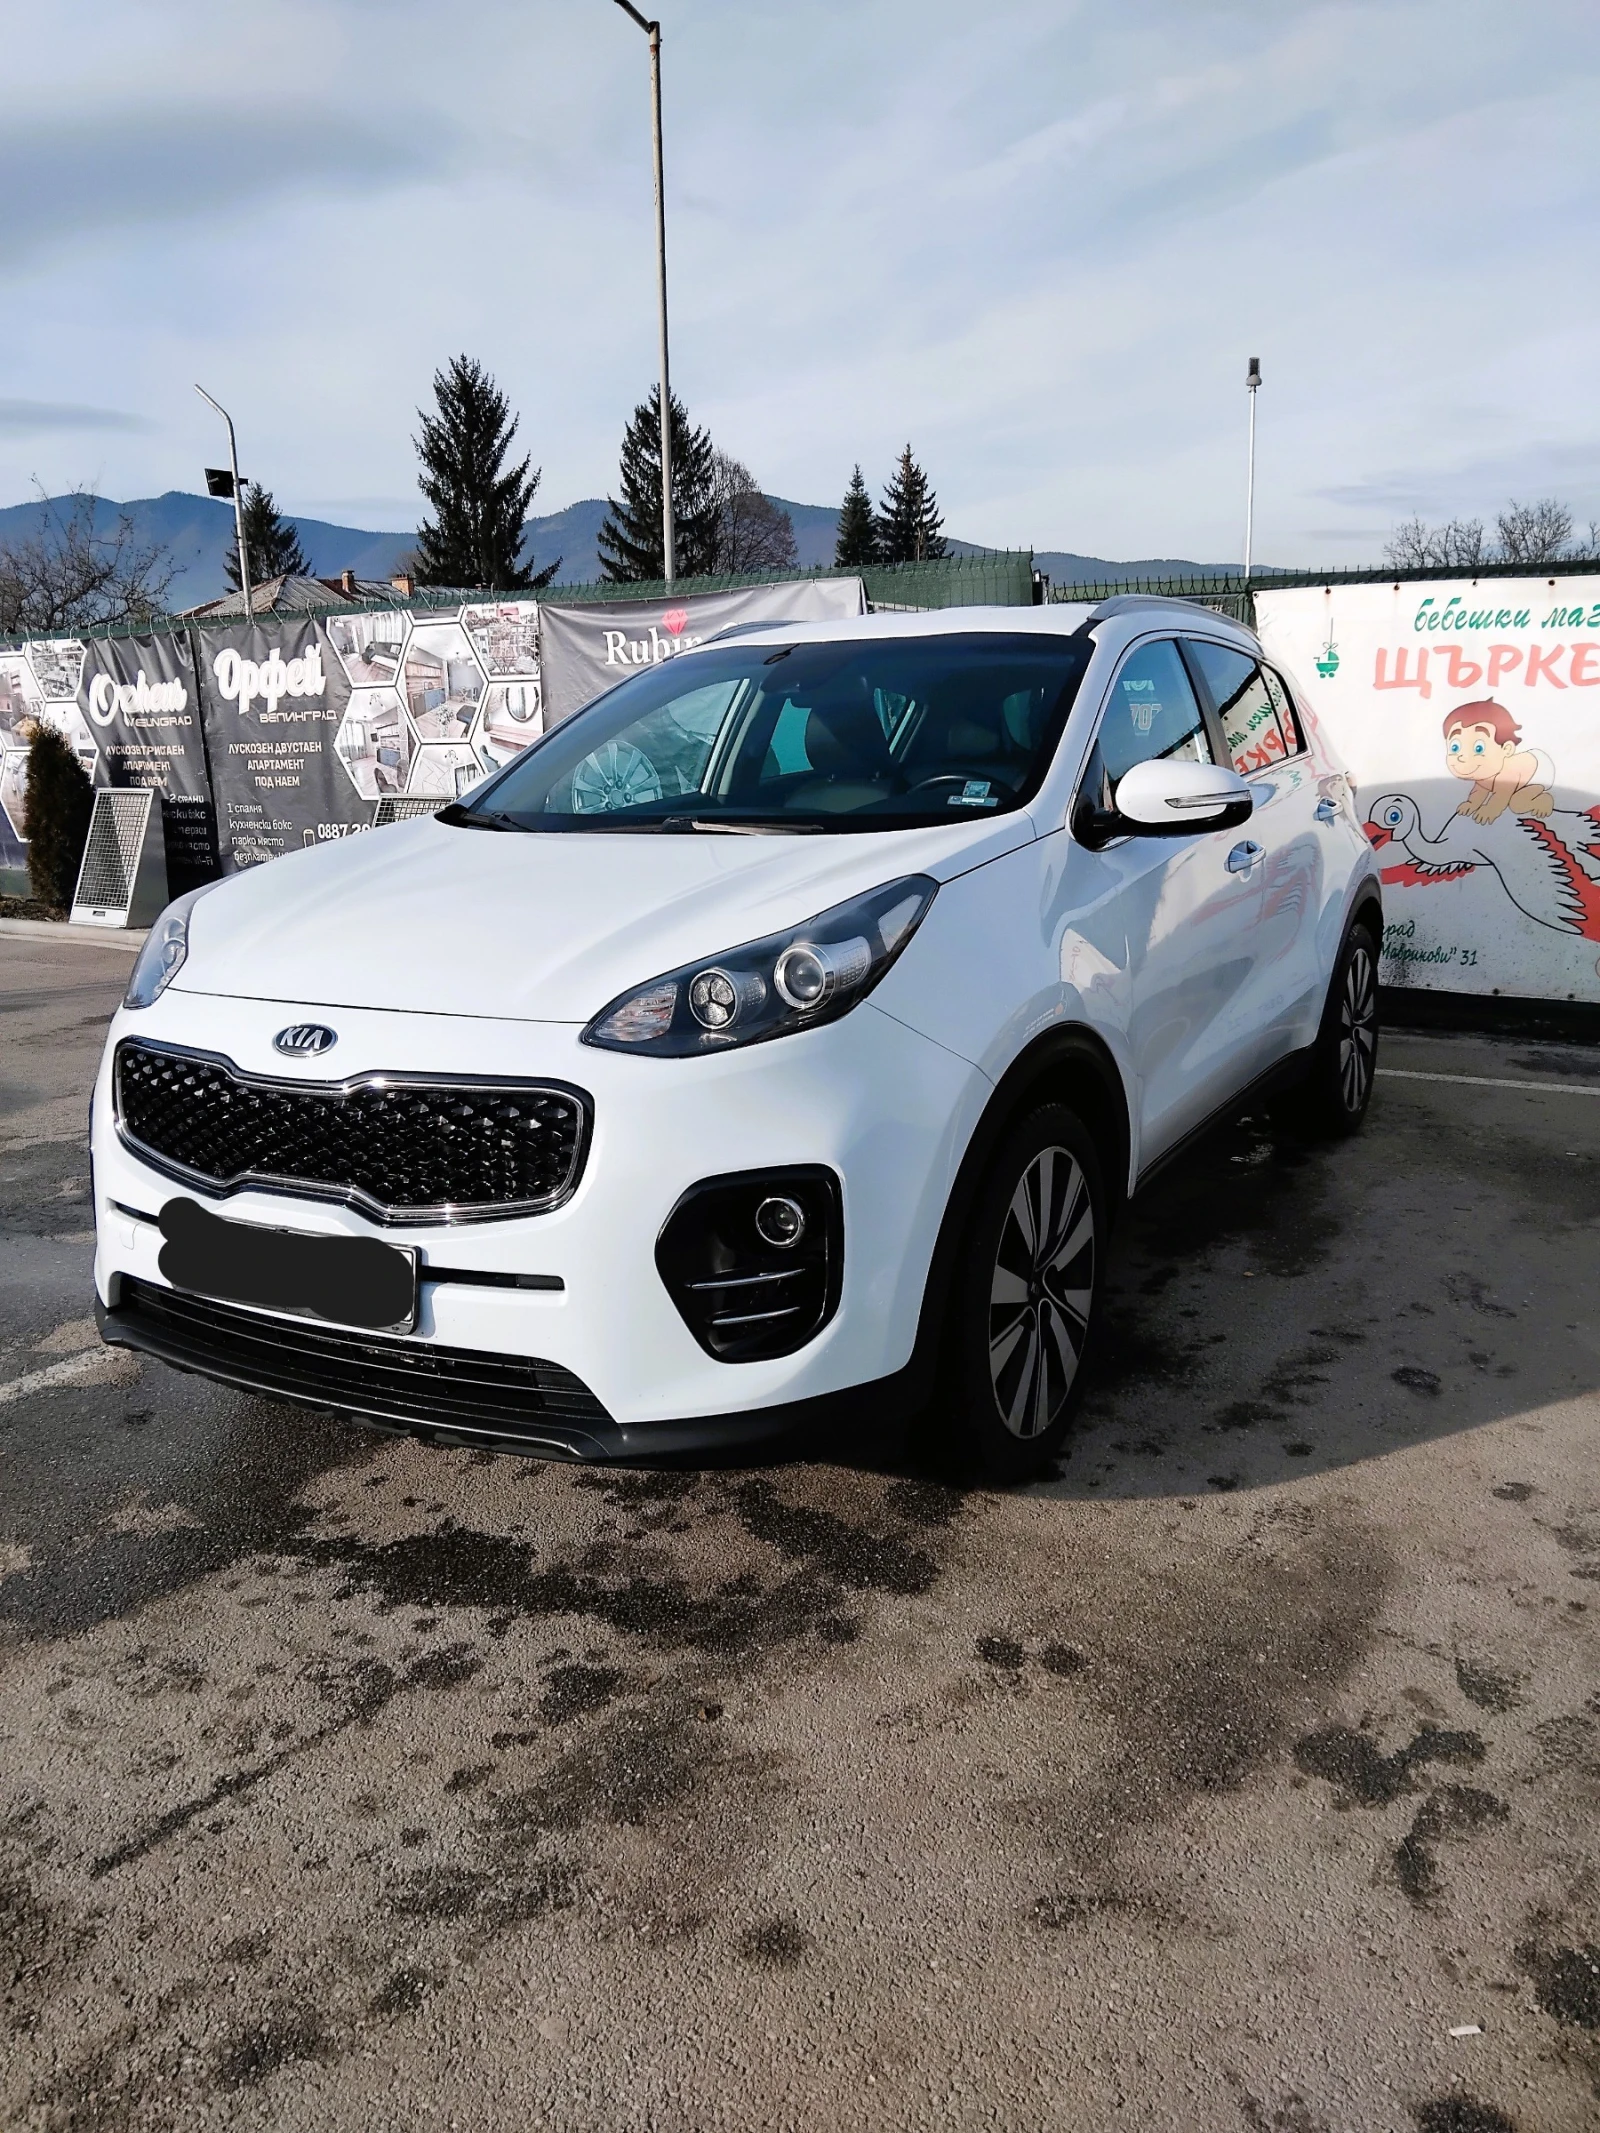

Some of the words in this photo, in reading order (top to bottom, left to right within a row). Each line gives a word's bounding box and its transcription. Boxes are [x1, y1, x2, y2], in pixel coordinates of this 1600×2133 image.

[1414, 597, 1531, 632] бебешки
[1372, 642, 1600, 699] ЩЪРКЕ
[213, 643, 327, 715] Орфей
[229, 743, 274, 754] ЛУСКОЗЕН
[275, 741, 322, 755] ДВУСТАЕН
[247, 759, 305, 771] АПАРТАМЕНТ
[254, 776, 274, 789] ПОД
[275, 776, 300, 787] НАЕМ
[169, 793, 176, 803] 2
[227, 803, 233, 813] 1
[234, 804, 263, 814] спалня
[272, 819, 293, 830] бокс
[317, 823, 349, 839] 0887
[1460, 950, 1477, 966] 31
[280, 1027, 324, 1050] KIA
